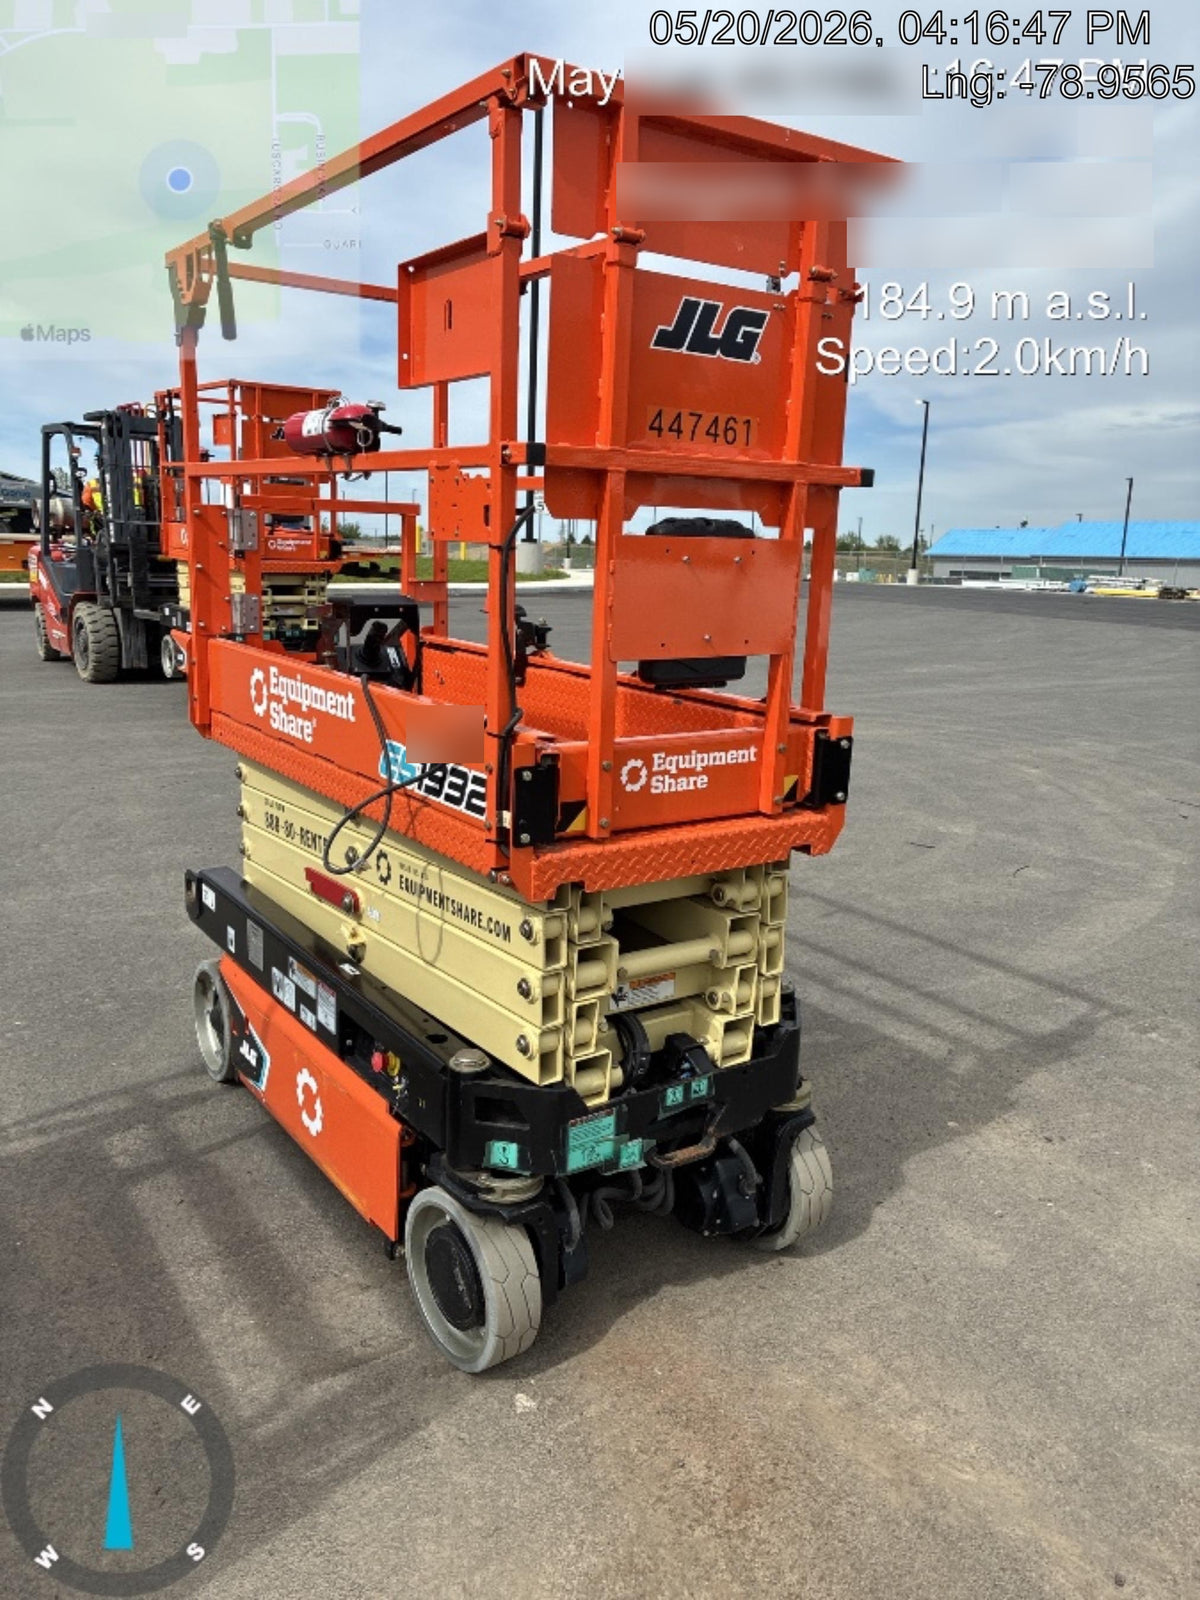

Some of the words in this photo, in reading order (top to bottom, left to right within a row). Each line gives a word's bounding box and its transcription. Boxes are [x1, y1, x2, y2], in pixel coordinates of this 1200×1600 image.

[650, 295, 771, 364] JLG
[648, 408, 752, 447] 447461
[269, 666, 356, 723] Equipment
[652, 745, 758, 774] Equipment
[650, 774, 709, 795] Share
